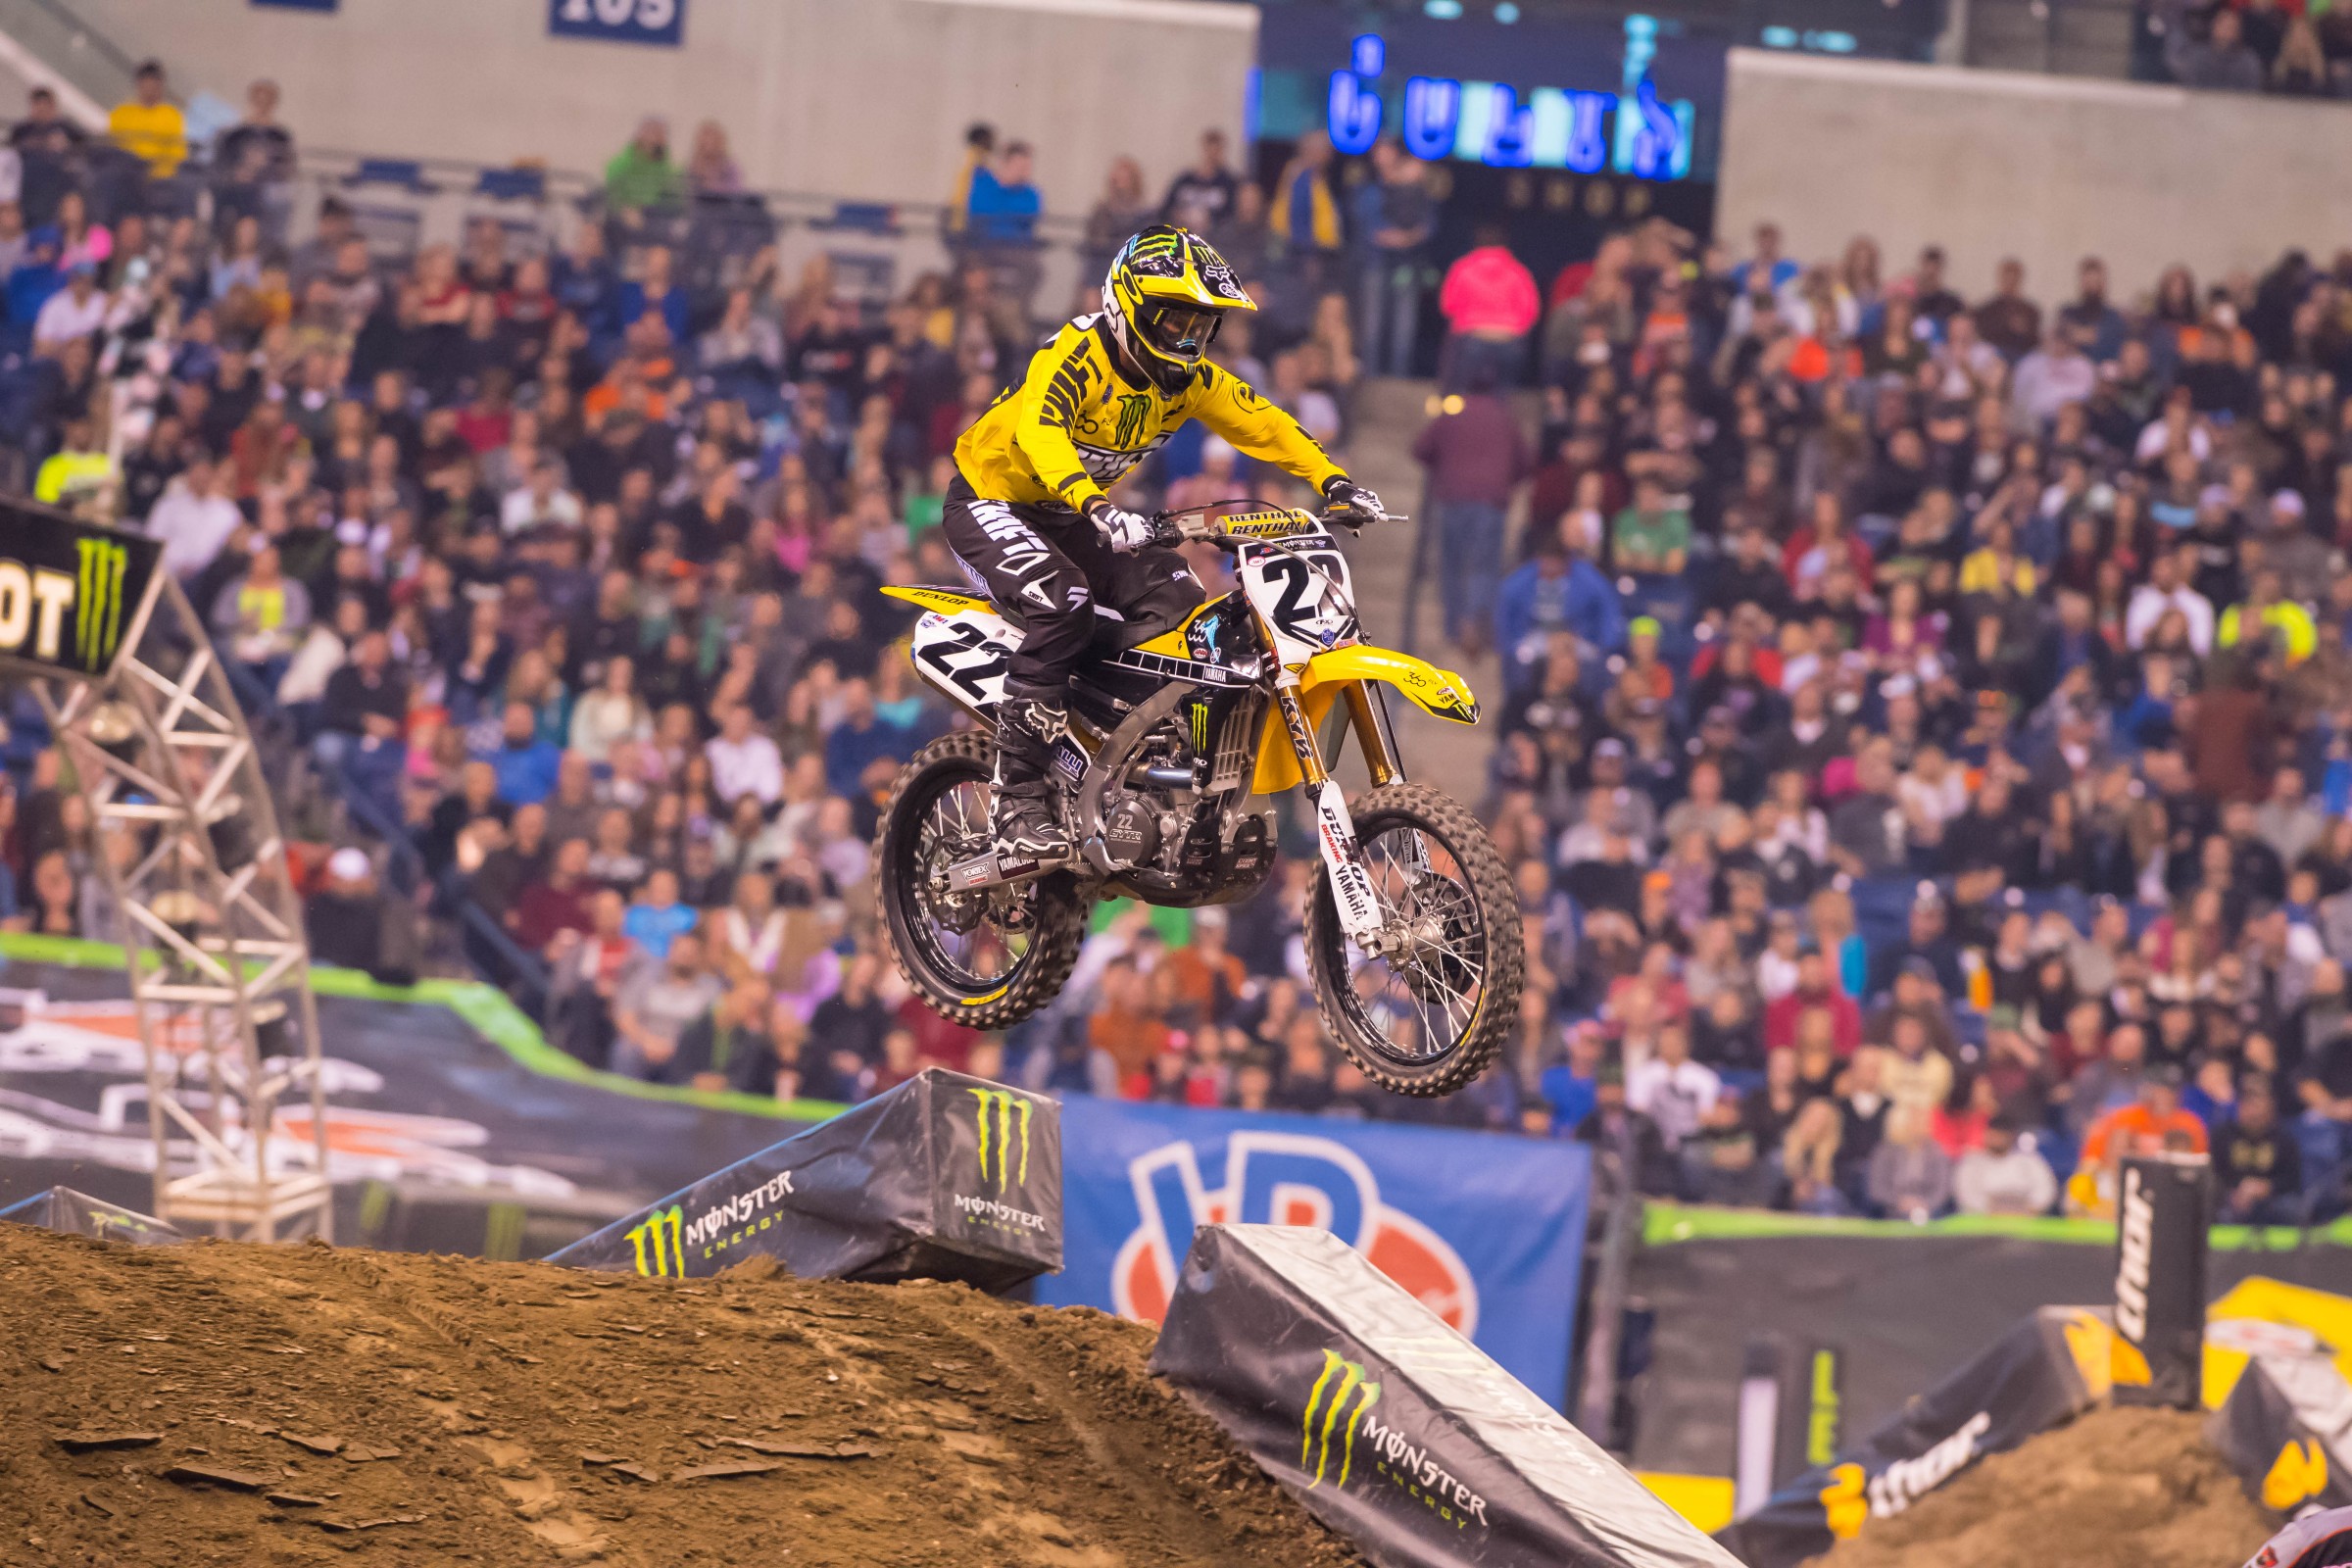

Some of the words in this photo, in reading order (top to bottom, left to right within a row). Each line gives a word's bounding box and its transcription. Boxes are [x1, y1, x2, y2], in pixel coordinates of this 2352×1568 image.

[911, 591, 970, 606] DUNLOP
[1261, 554, 1356, 635] 22
[917, 621, 1016, 702] 22
[1204, 667, 1226, 682] YAMAHA
[1282, 696, 1314, 760] KYB
[1109, 828, 1143, 841] GYTR
[1118, 814, 1134, 829] 22
[1321, 824, 1343, 863] BRAKING
[962, 863, 990, 879] VORTEX
[1335, 864, 1369, 921] YAMAHA
[687, 1170, 794, 1247] MONSTER
[955, 1194, 1046, 1231] MONSTER
[967, 1215, 1032, 1237] ENERGY
[705, 1210, 783, 1259] ENERGY
[1362, 1415, 1488, 1527] MONSTER
[1377, 1461, 1466, 1529] ENERGY
